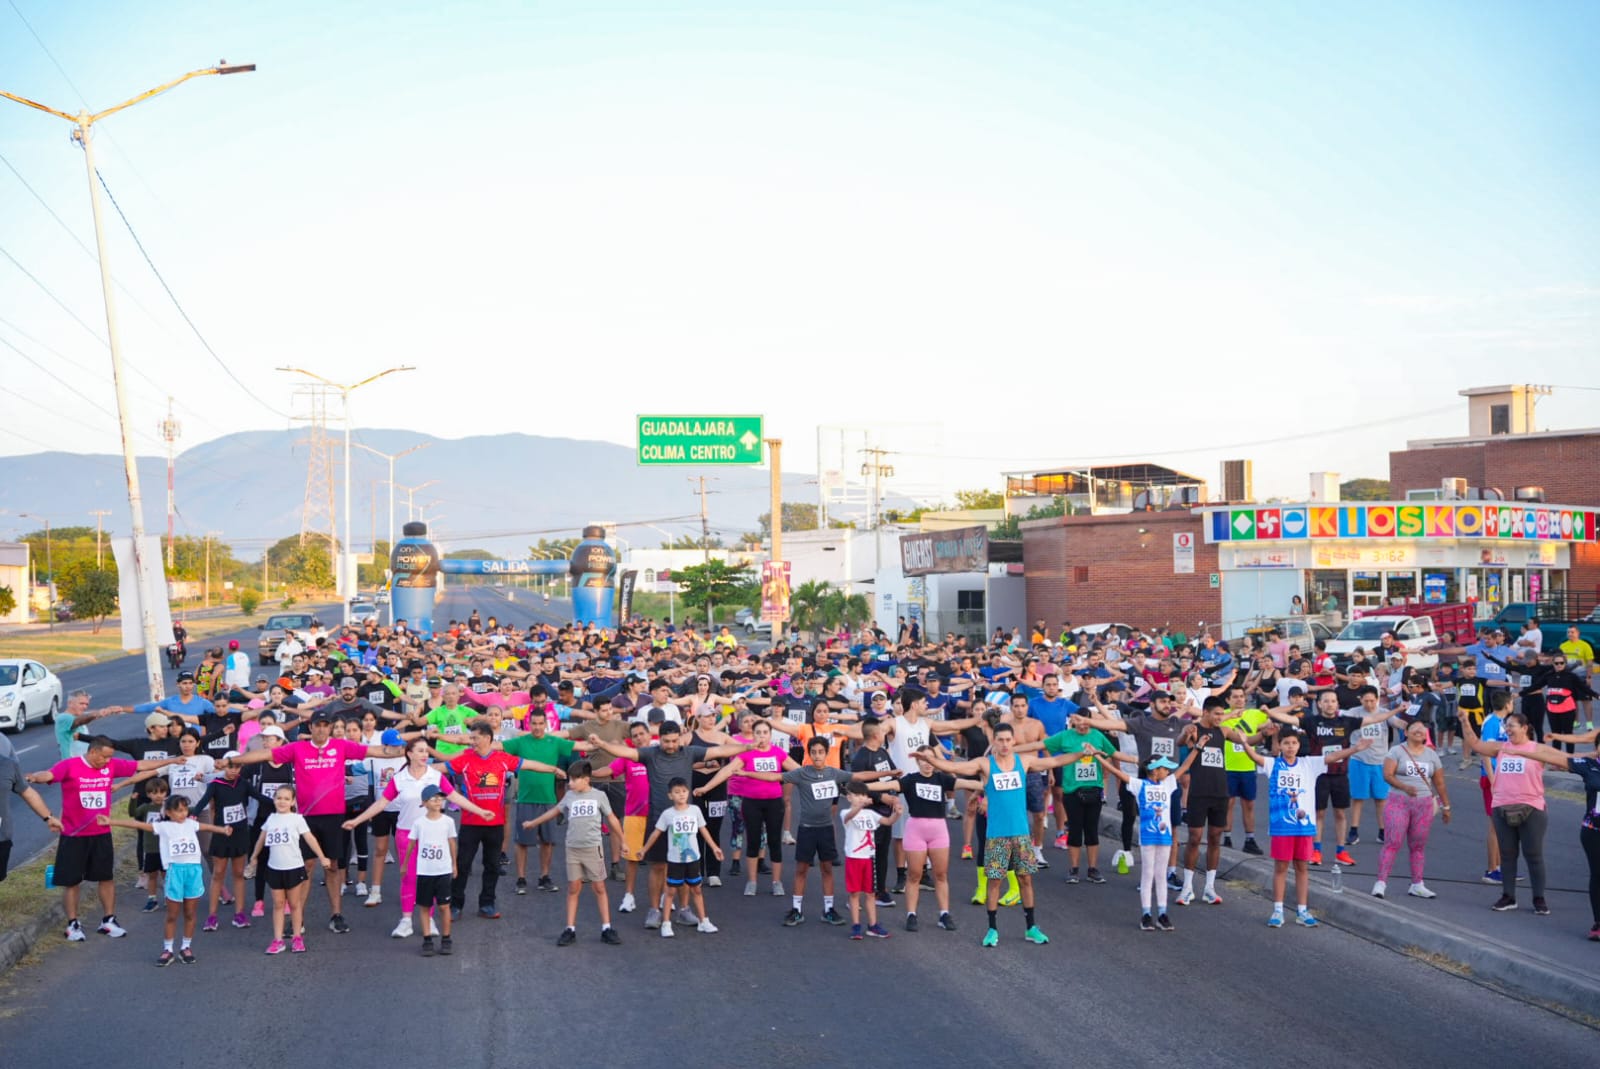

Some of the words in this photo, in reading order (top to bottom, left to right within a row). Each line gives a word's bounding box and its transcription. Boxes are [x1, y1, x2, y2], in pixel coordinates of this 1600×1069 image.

[642, 421, 735, 436] GUADALAJARA
[642, 445, 685, 460] COLIMA
[690, 445, 736, 460] CENTRO
[1310, 506, 1483, 535] KIOSKO
[482, 560, 530, 573] SALIDA
[1316, 726, 1334, 736] 10K
[1363, 727, 1380, 737] 025
[907, 736, 924, 748] 034
[1154, 743, 1172, 754] 233
[1203, 753, 1222, 765] 236
[756, 761, 775, 771] 506
[1501, 761, 1522, 772] 393
[1077, 767, 1095, 778] 234
[174, 777, 195, 788] 414
[996, 777, 1019, 789] 374
[1280, 776, 1301, 788] 391
[264, 788, 277, 798] 57
[815, 786, 835, 798] 377
[918, 788, 940, 801] 375
[1147, 790, 1167, 802] 390
[82, 797, 103, 808] 576
[572, 805, 594, 816] 368
[711, 807, 723, 816] 61
[675, 821, 695, 832] 367
[267, 832, 289, 844] 383
[172, 843, 196, 854] 329
[421, 847, 443, 860] 530
